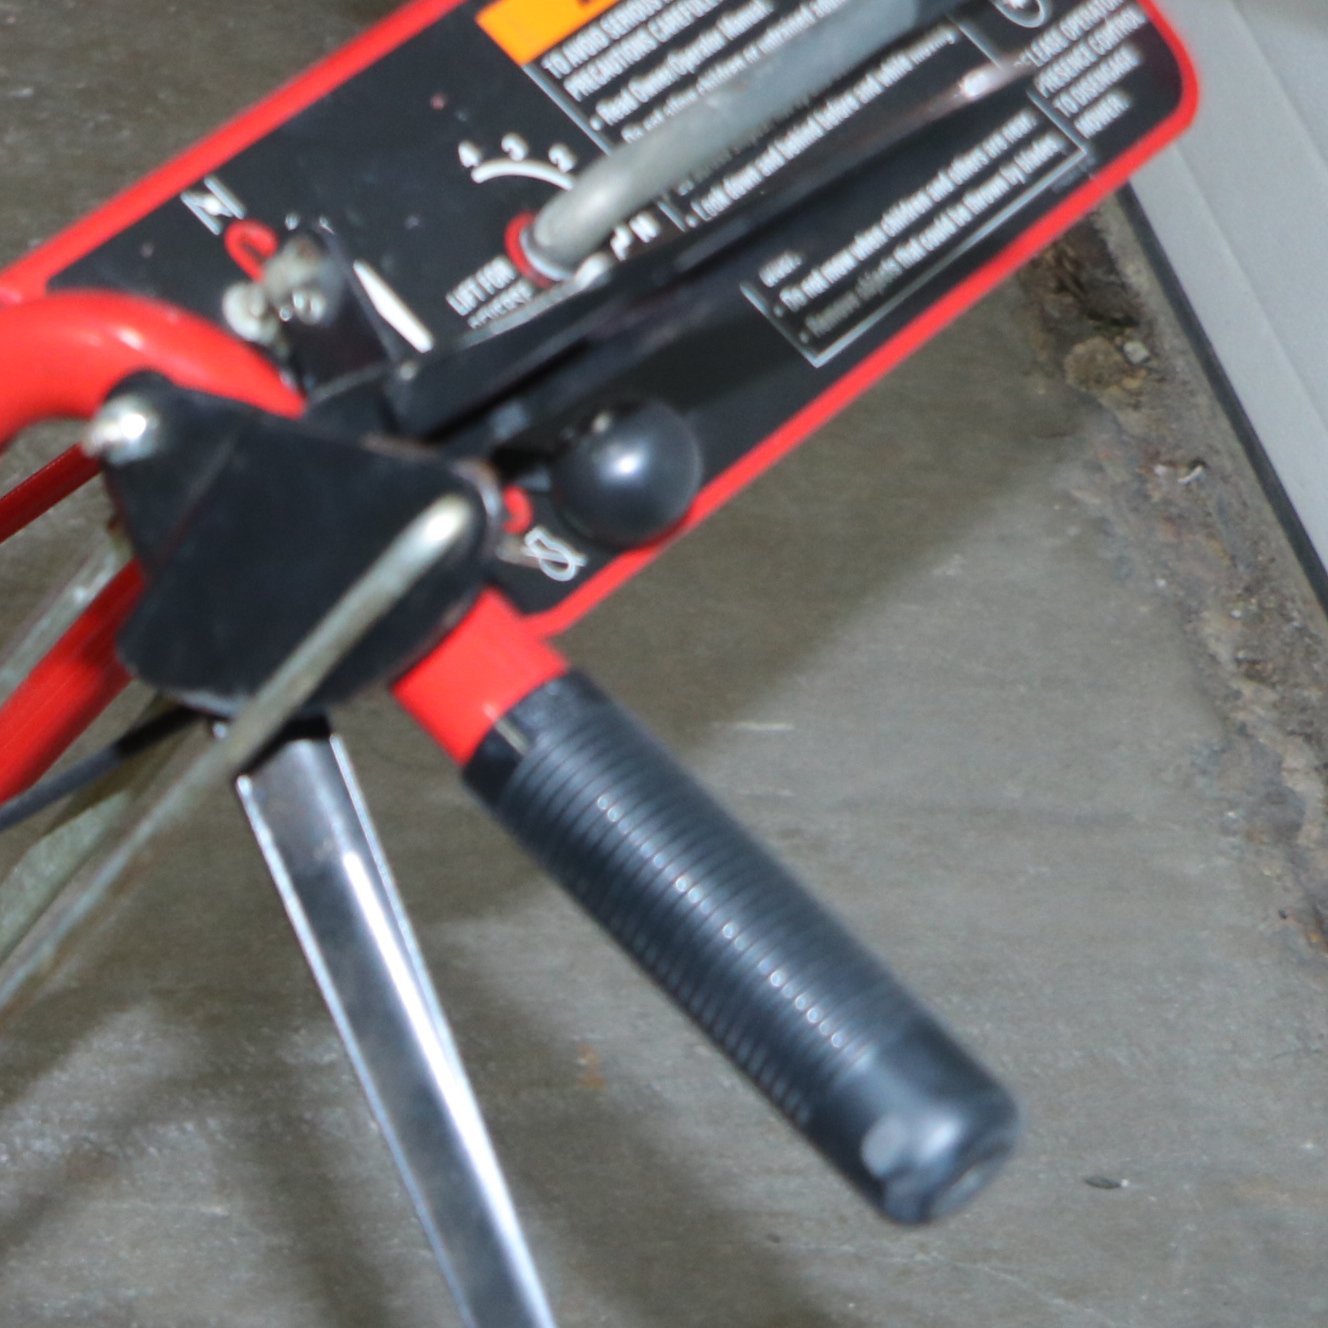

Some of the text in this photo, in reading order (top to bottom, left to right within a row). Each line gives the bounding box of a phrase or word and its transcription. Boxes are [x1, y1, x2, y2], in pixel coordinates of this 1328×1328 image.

[562, 27, 610, 65] AVOID
[563, 26, 660, 101] PRECAUTIONS
[1031, 3, 1147, 95] PRESENCE CONTROL
[1066, 45, 1141, 105] DISENGAGE
[501, 133, 528, 161] 3
[548, 144, 575, 173] 2
[689, 73, 883, 220] Look down and behind before and
[797, 269, 829, 297] not
[819, 250, 857, 282] mow
[846, 224, 889, 260] when
[877, 188, 934, 236] children
[922, 171, 955, 200] and
[944, 145, 990, 183] others
[891, 236, 926, 267] that
[915, 213, 957, 249] could
[961, 172, 1010, 213] thrown
[445, 256, 516, 316] LIFT FOR
